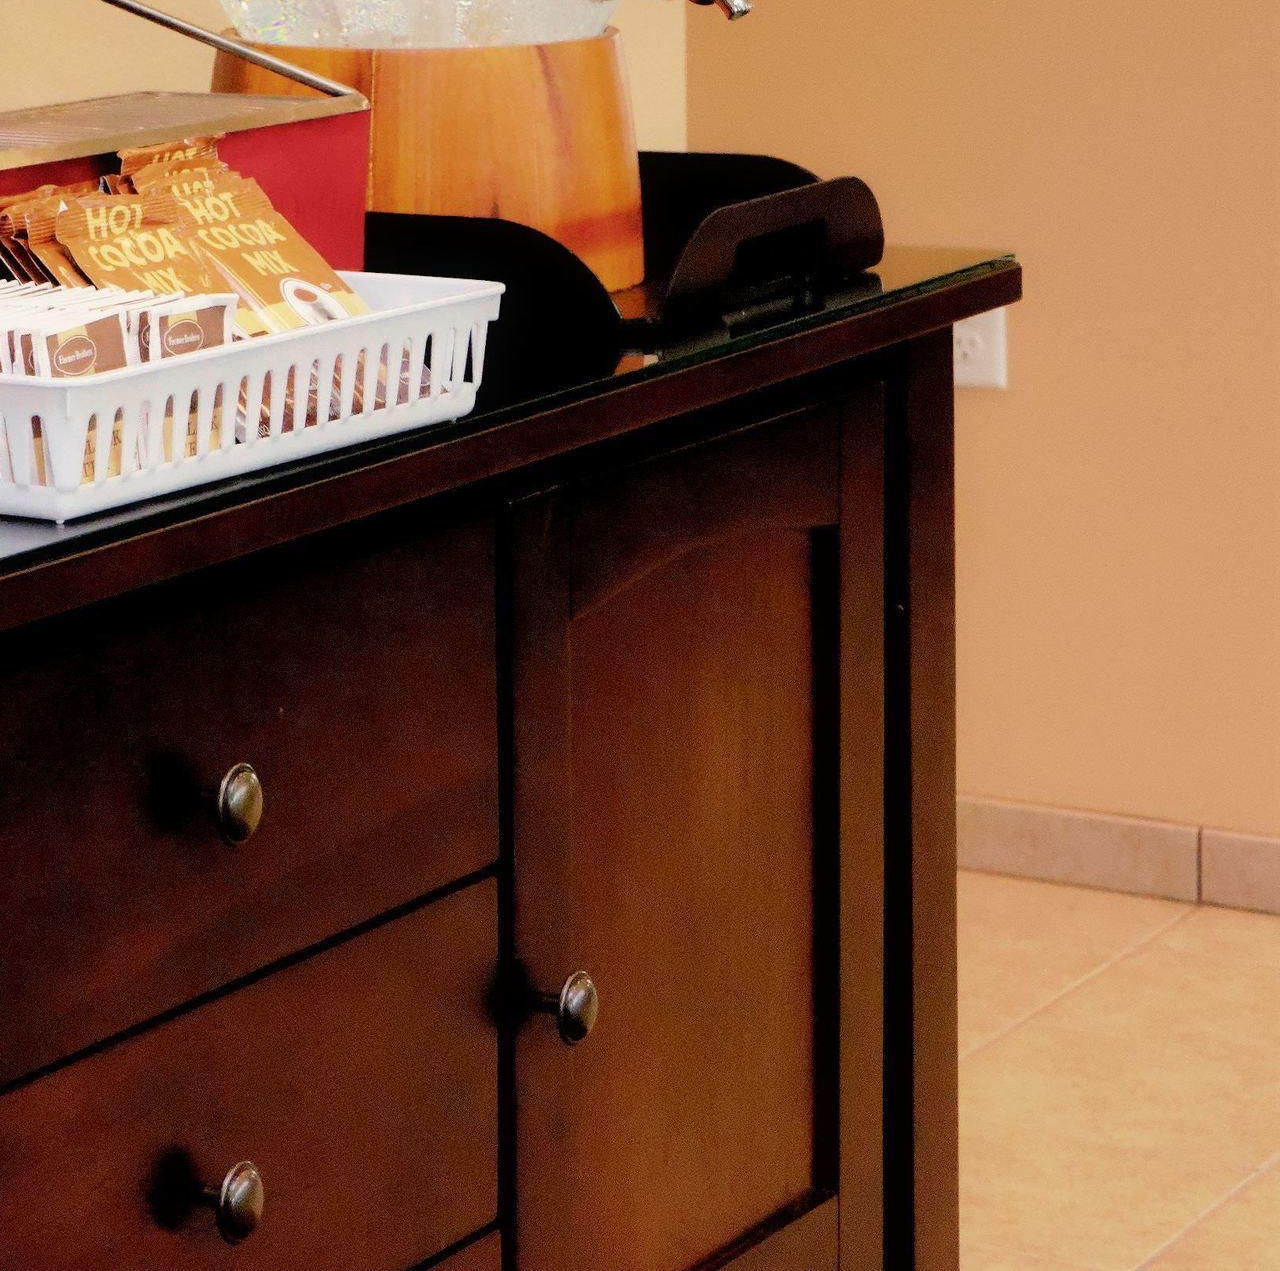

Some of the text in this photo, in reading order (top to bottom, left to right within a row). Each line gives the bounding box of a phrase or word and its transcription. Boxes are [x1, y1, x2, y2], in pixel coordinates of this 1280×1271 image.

[85, 203, 143, 240] HOT
[183, 191, 240, 225] HOT
[88, 228, 189, 272] COCOA
[197, 219, 287, 250] COCOA
[241, 249, 300, 276] MIX
[132, 267, 193, 296] MIX
